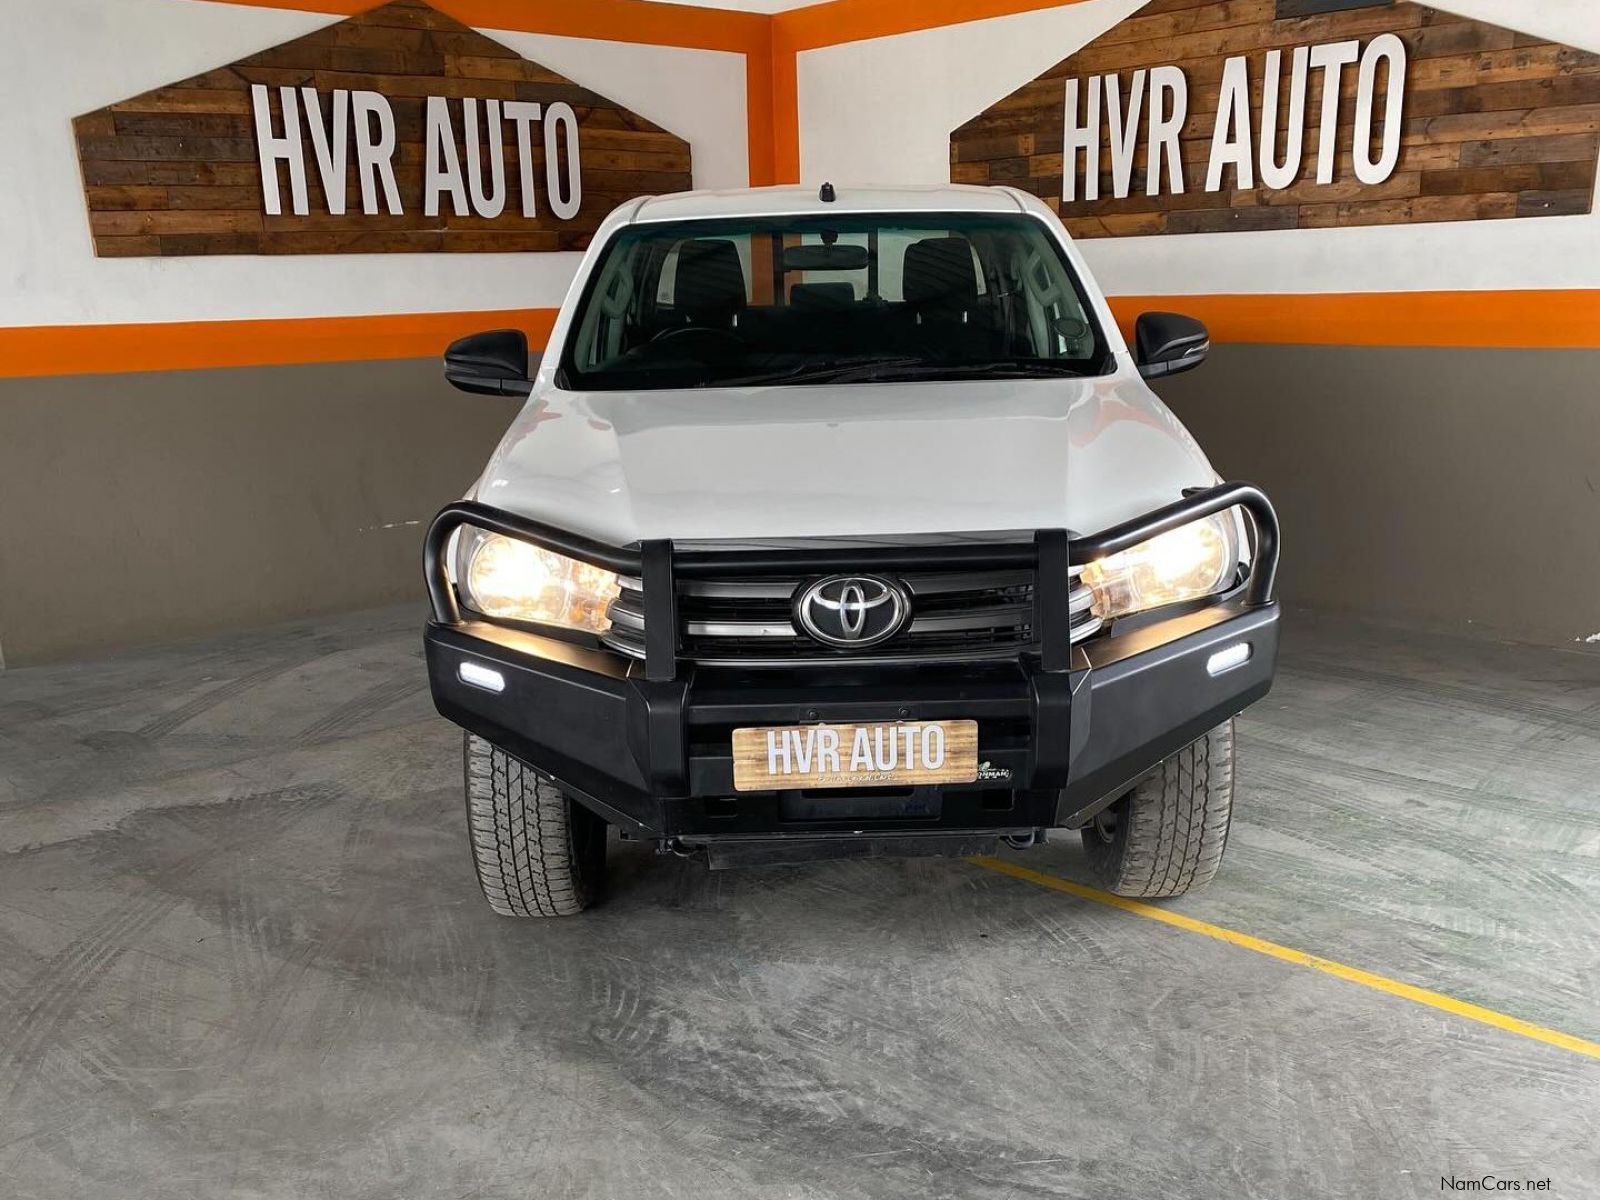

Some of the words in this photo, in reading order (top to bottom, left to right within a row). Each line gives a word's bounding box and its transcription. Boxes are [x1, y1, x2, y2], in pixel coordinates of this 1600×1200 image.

[251, 84, 404, 216] HVR
[424, 96, 582, 220] AUTO
[1063, 65, 1188, 202] HVR
[1204, 33, 1406, 193] AUTO
[767, 729, 841, 775] HVR
[850, 725, 944, 772] AUTO
